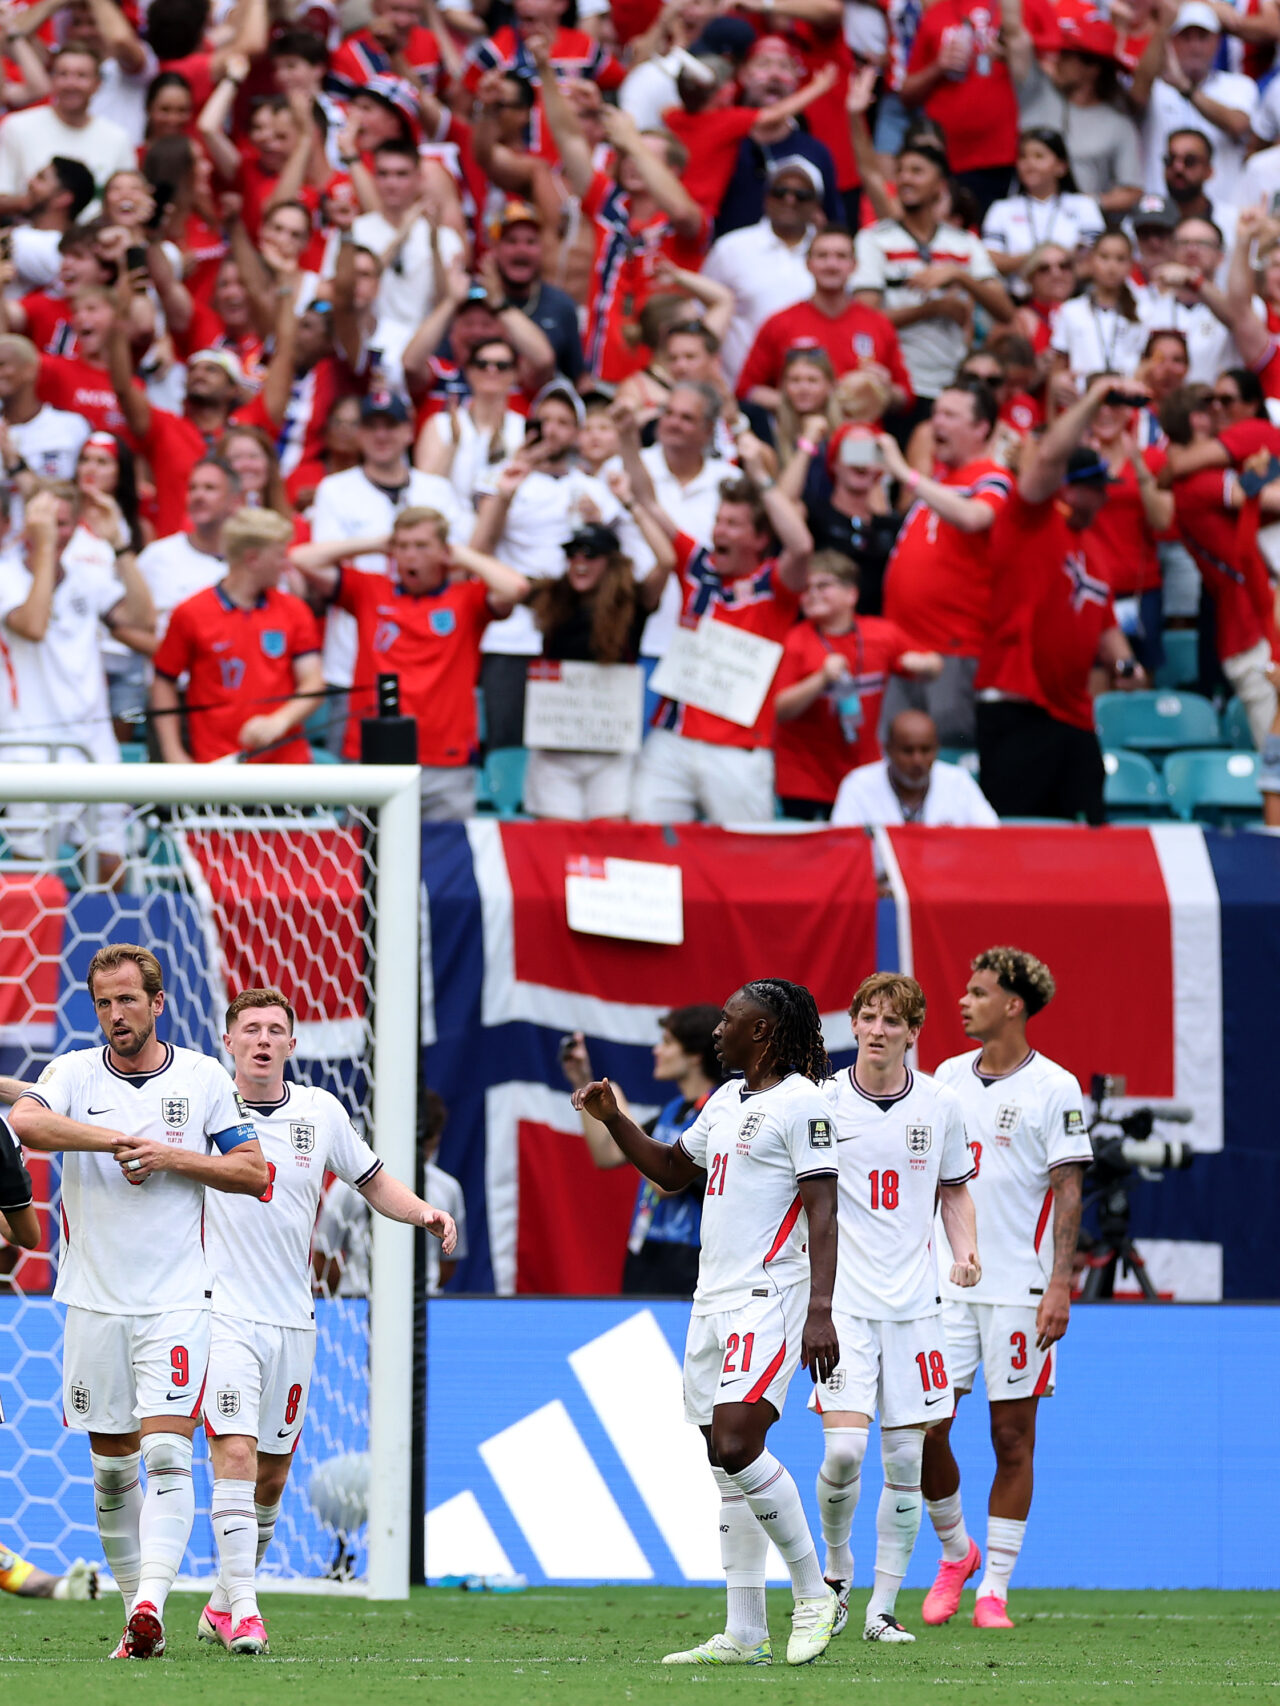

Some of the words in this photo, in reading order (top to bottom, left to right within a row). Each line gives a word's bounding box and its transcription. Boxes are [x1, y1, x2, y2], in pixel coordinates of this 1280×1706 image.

[707, 1153, 728, 1195] 21
[868, 1169, 899, 1210] 18
[170, 1345, 189, 1387] 9
[723, 1332, 755, 1373] 21
[915, 1350, 948, 1392] 18
[1010, 1331, 1027, 1370] 3
[285, 1384, 302, 1424] 8
